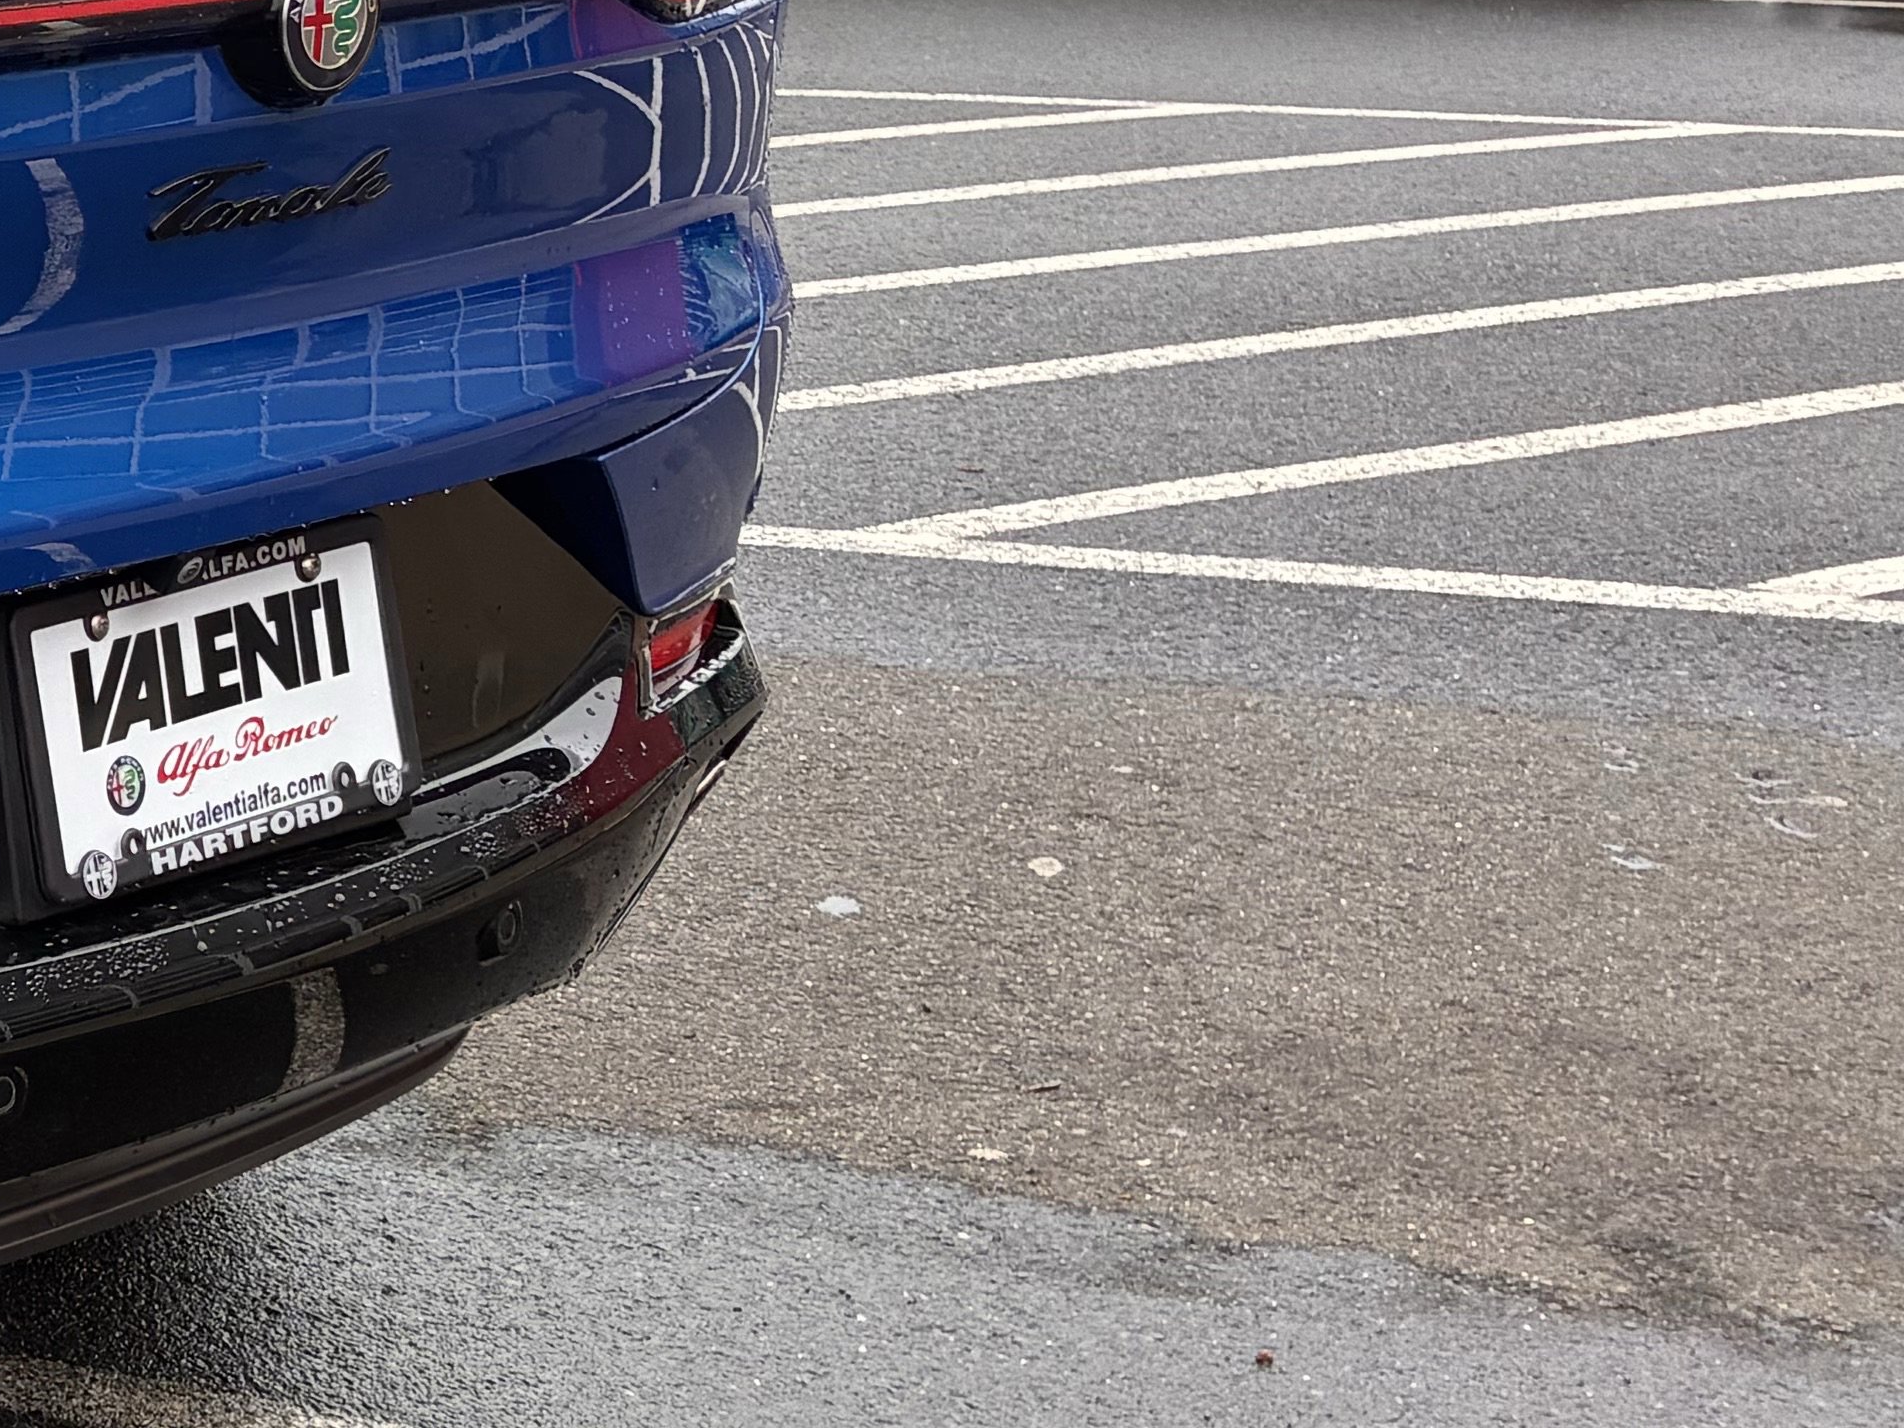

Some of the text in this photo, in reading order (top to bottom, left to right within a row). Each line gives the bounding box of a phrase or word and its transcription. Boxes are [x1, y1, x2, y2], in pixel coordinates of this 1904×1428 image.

[146, 146, 392, 241] Tonale
[71, 578, 351, 753] VALENTI
[156, 734, 231, 797] Alfa
[233, 715, 339, 762] Romeo
[149, 794, 344, 876] HARTFORD
